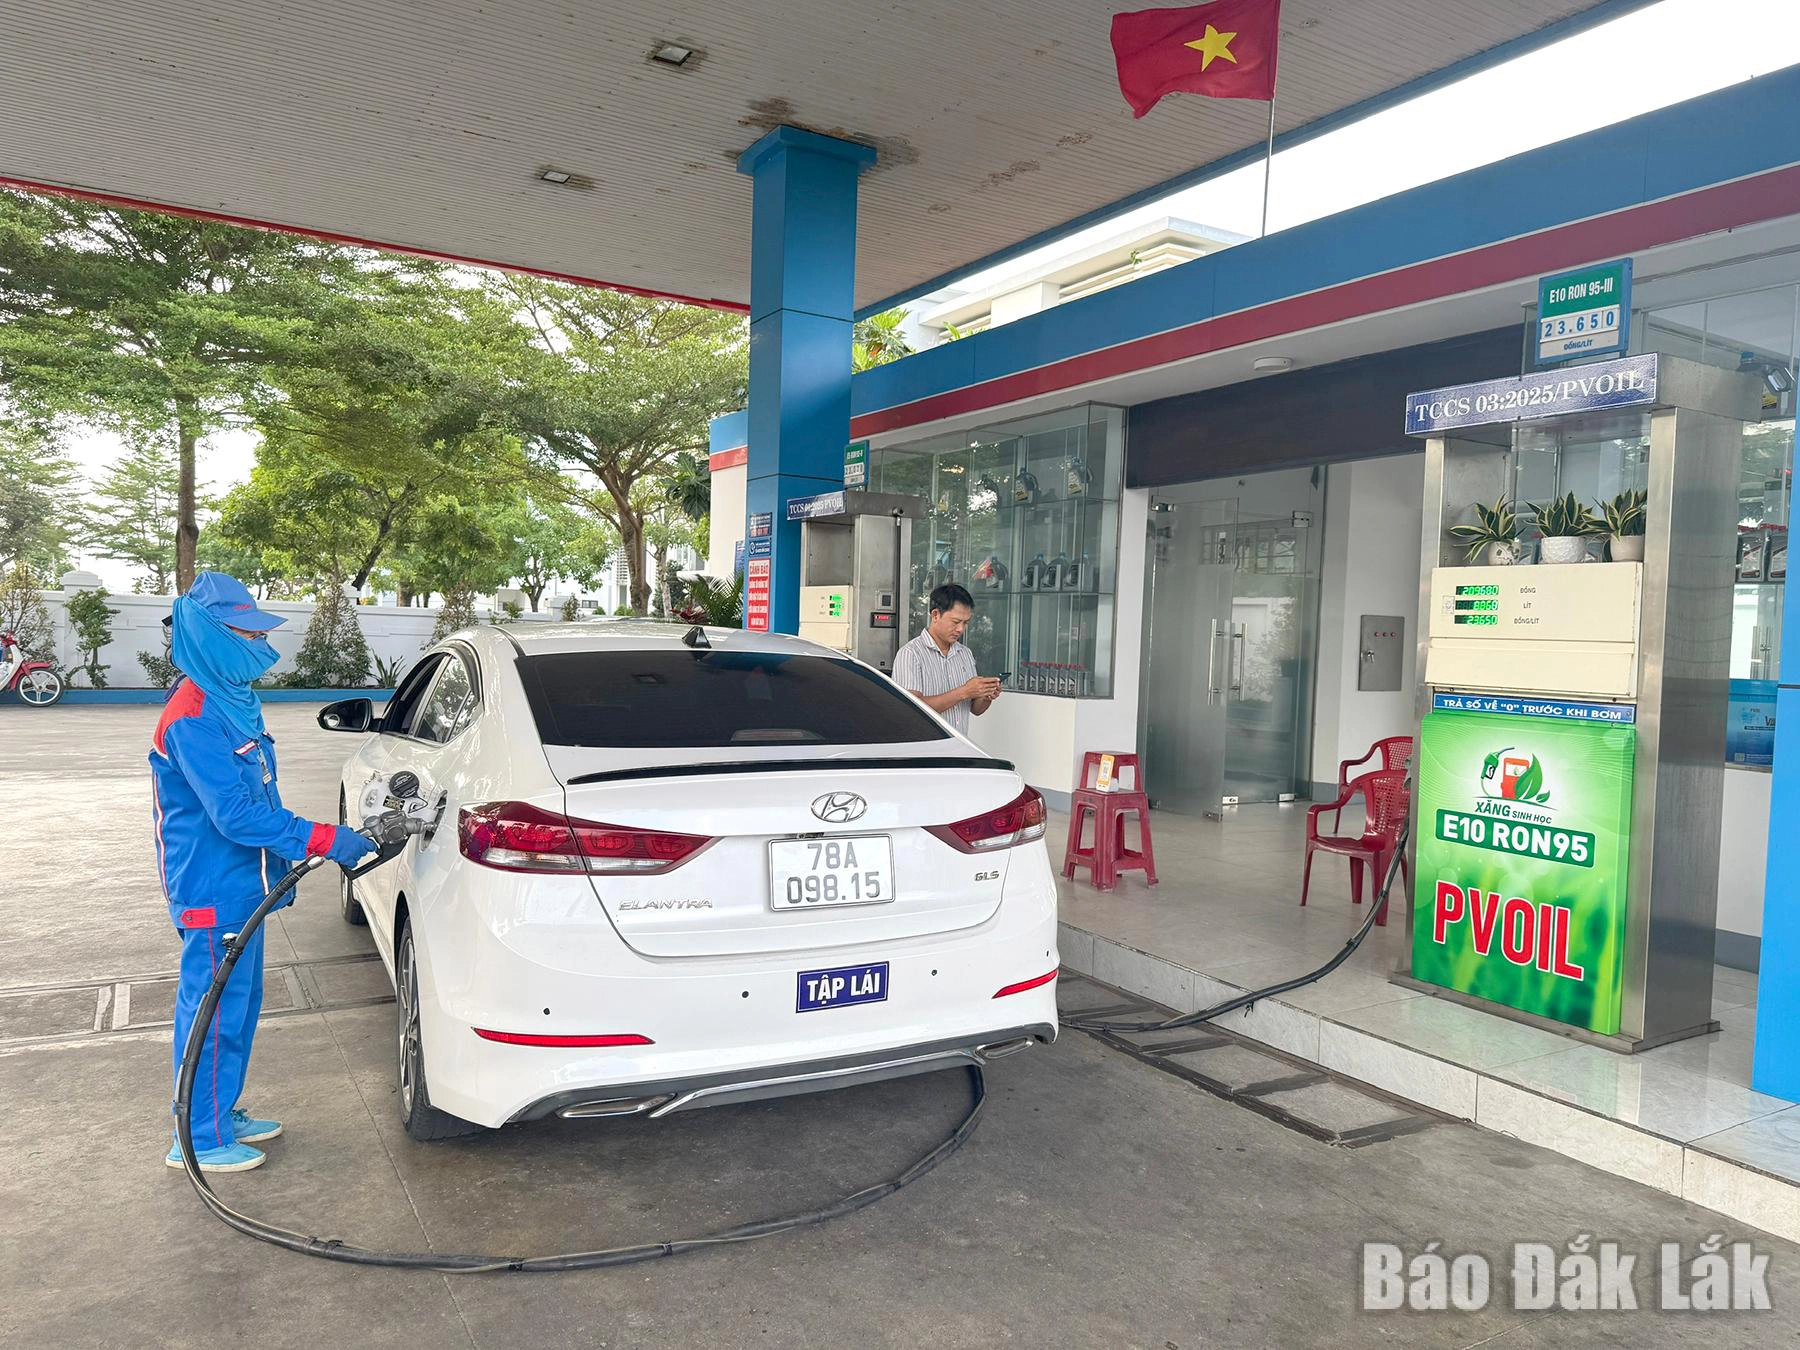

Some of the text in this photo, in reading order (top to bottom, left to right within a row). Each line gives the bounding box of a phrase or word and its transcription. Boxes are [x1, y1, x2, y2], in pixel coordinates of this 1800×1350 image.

[1549, 277, 1613, 304] E10 RON 95-III
[1545, 311, 1614, 337] 23.650
[1415, 369, 1645, 423] TCCS 03:2025/PVOIL
[1523, 601, 1532, 609] LÍT
[1443, 698, 1464, 708] TRẢ
[1466, 698, 1481, 709] SỐ
[1484, 699, 1498, 710] VỀ
[1522, 704, 1563, 715] TRƯỚC
[1566, 708, 1587, 717] KHI
[1591, 709, 1622, 720] BƠM
[1474, 800, 1552, 825] XĂNG SINH HỌC
[1443, 814, 1588, 862] E10 RON95
[807, 841, 858, 871] 78A
[786, 871, 880, 905] 098.15
[974, 869, 1000, 883] GLS
[618, 898, 713, 911] ELANTRA
[1433, 880, 1584, 982] PVOIL
[807, 969, 881, 1002] TẬP LÁI
